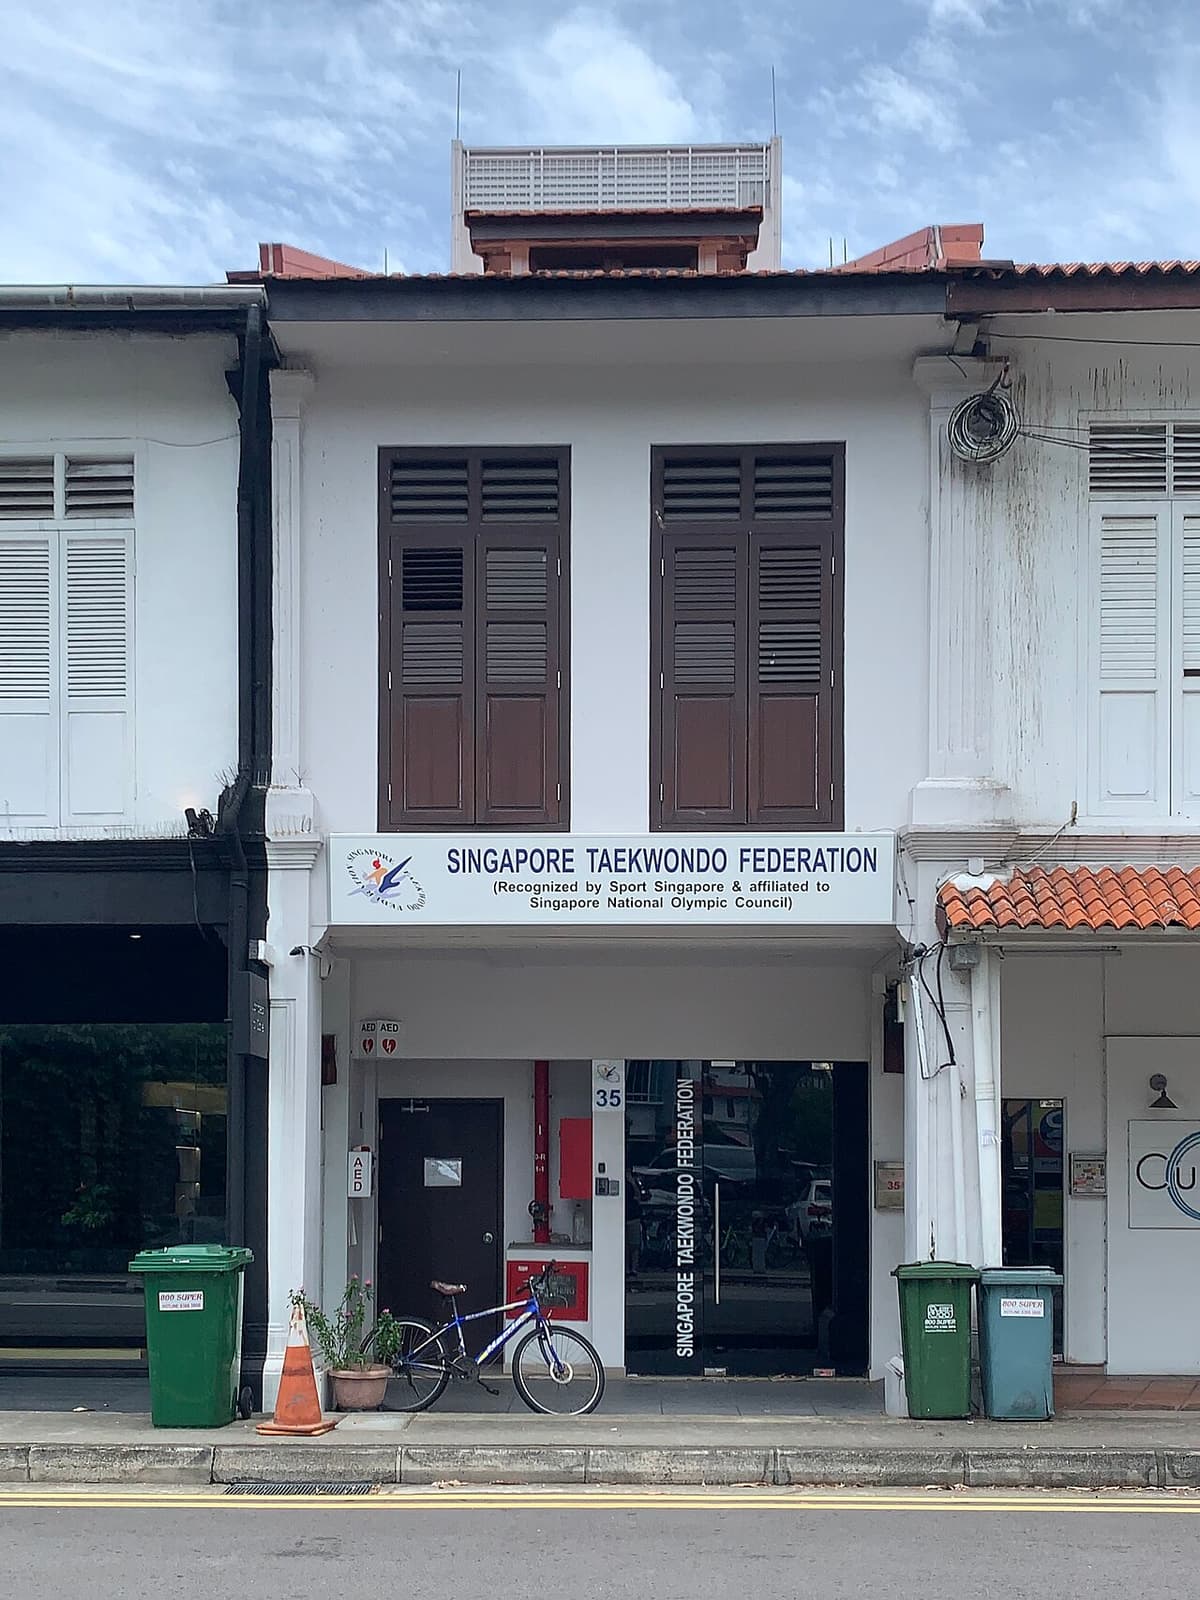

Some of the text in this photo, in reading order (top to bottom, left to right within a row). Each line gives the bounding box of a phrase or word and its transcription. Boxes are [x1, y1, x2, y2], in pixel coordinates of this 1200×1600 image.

[448, 847, 877, 874] SINGAPORE TAEKWONDO FEDERATION
[494, 880, 830, 896] (Recognized by Sport Singapore & affiliated to
[530, 896, 793, 912] Singapore National Olympic Council)
[361, 1023, 376, 1032] AED
[380, 1023, 399, 1033] AED
[596, 1089, 621, 1107] 35
[353, 1157, 363, 1192] AED
[677, 1079, 694, 1357] SINGAPORE TAEKWONDO FEDERATION
